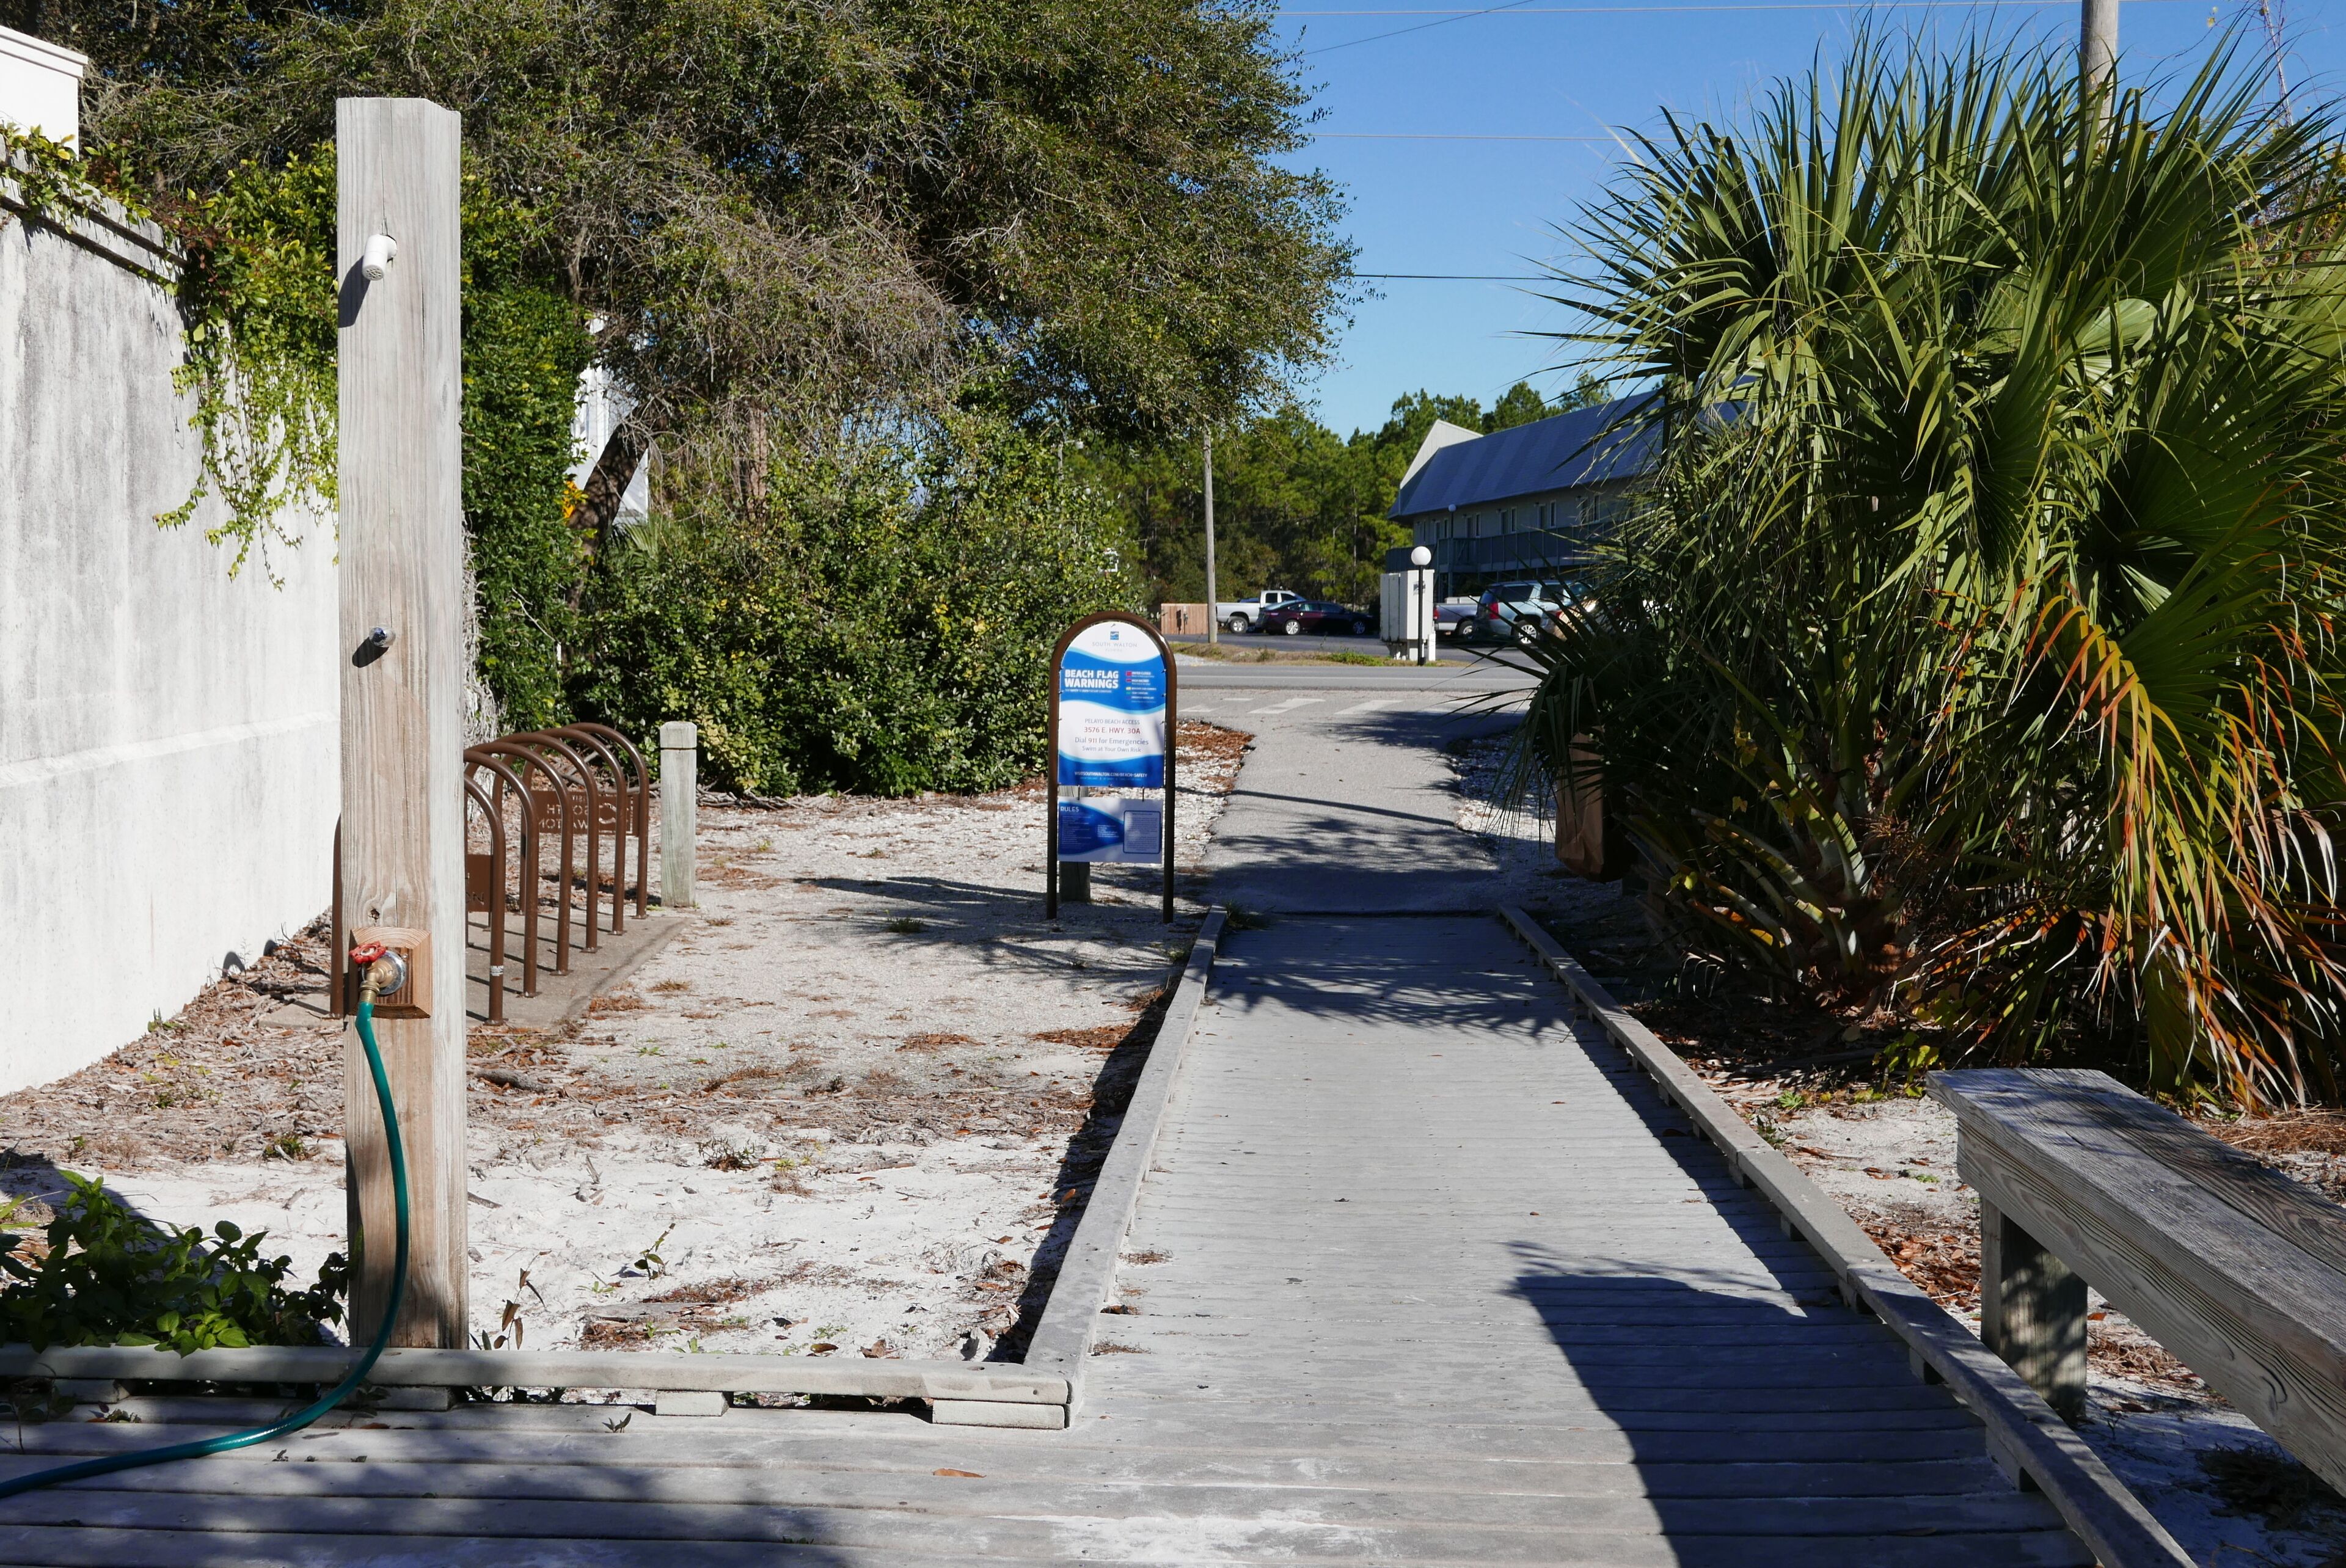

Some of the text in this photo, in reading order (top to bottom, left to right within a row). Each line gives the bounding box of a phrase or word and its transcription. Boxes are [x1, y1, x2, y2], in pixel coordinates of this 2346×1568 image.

[1065, 669, 1119, 679] BEACH FLAG
[1064, 678, 1119, 688] WARNINGS
[1109, 738, 1149, 746] Emergencies
